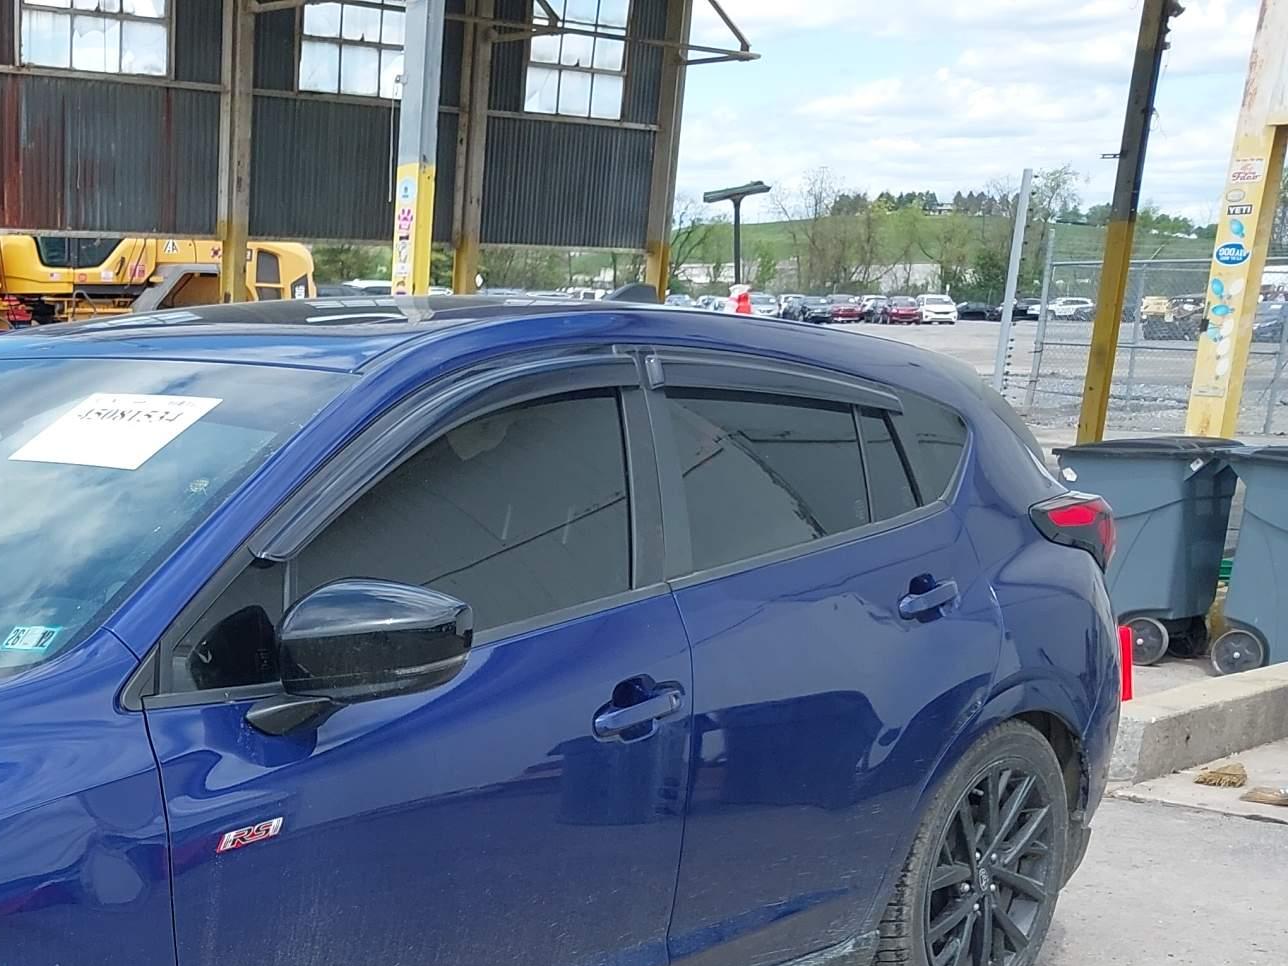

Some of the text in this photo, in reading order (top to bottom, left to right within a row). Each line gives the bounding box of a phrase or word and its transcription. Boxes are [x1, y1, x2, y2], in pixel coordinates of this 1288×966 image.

[1228, 206, 1252, 214] YETI
[35, 630, 55, 648] 12
[230, 820, 274, 849] RS
